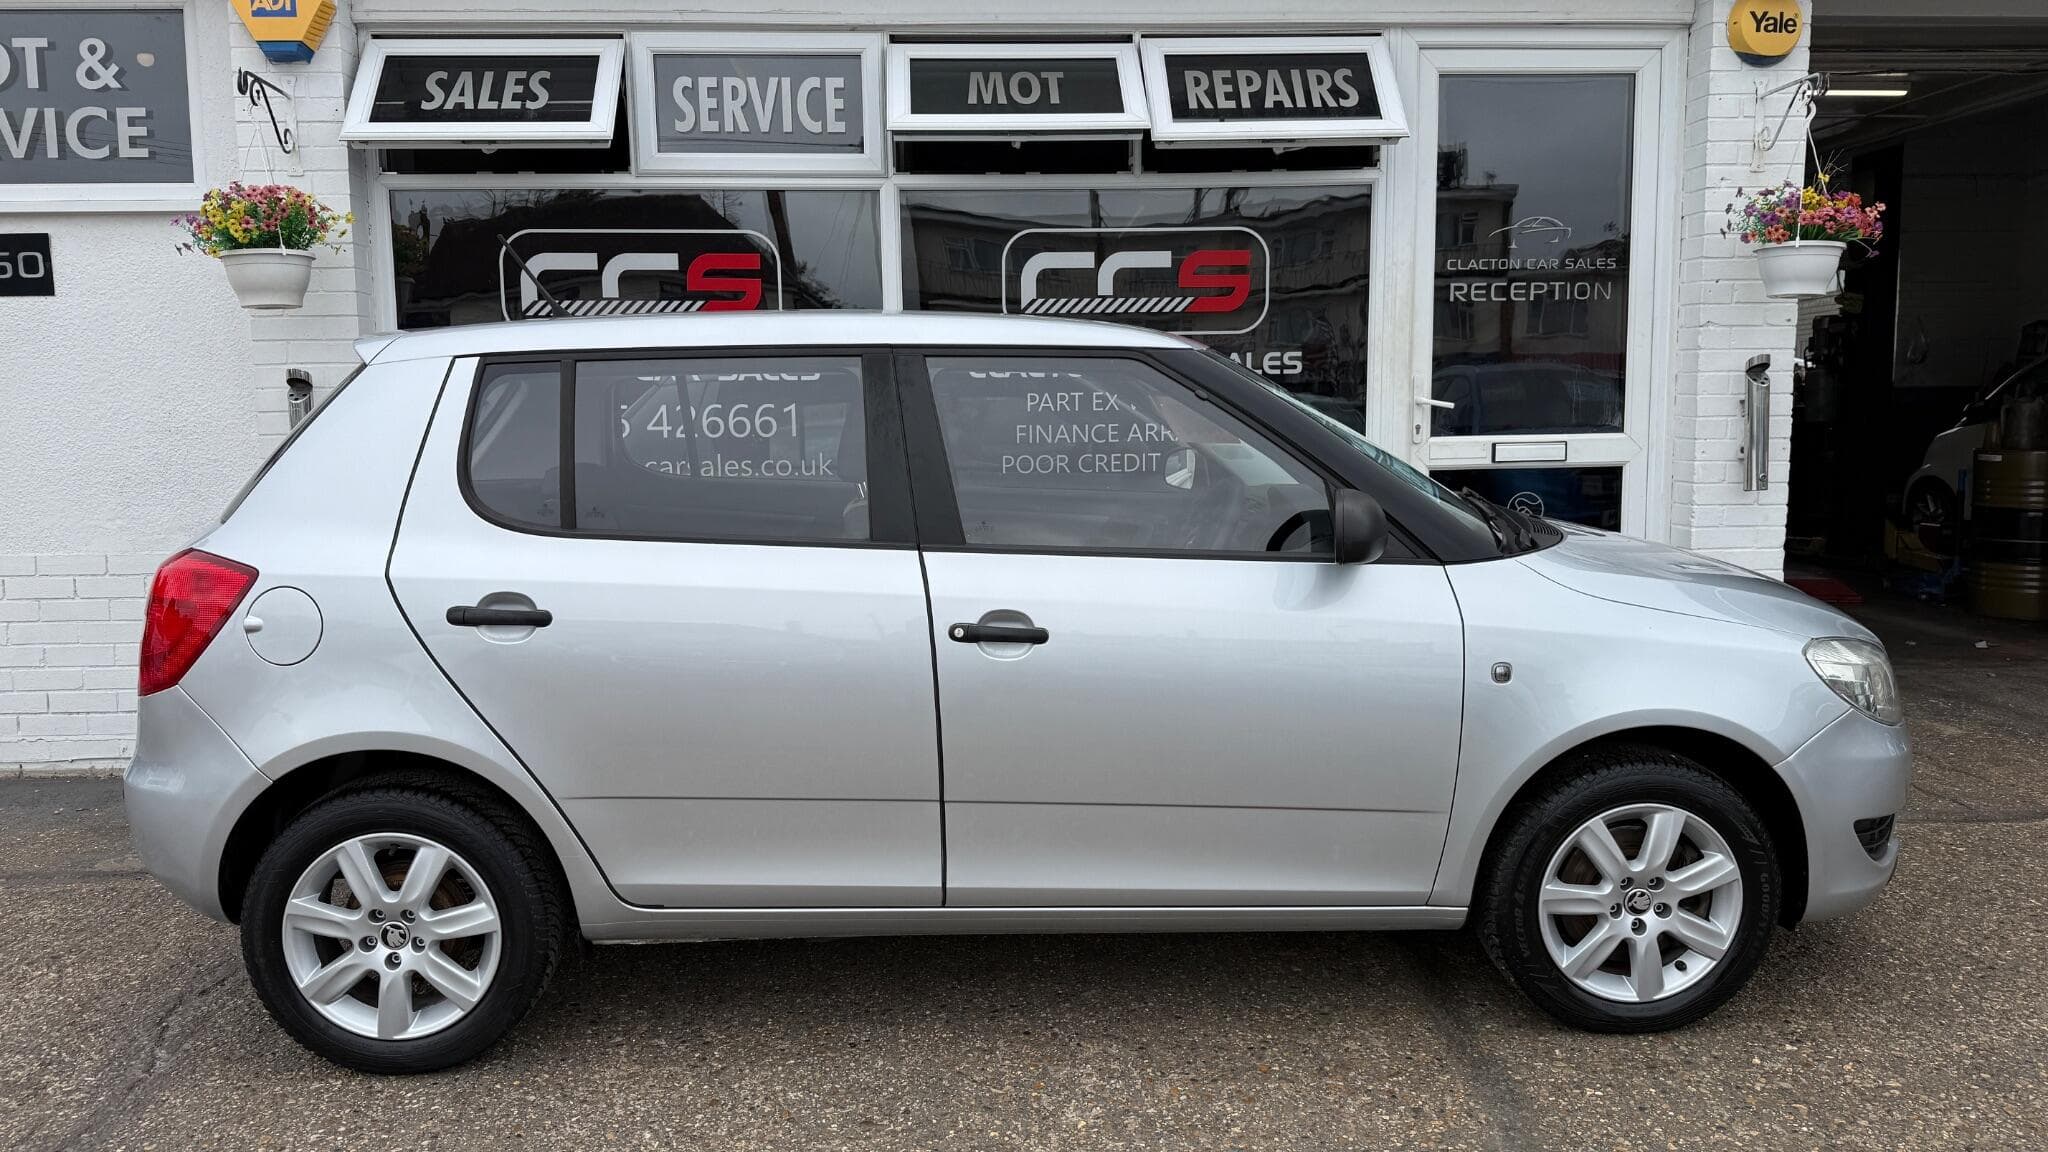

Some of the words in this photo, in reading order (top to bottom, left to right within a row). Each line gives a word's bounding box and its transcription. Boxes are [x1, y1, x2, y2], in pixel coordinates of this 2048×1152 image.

[1750, 11, 1797, 33] Yale
[76, 37, 122, 90] &
[421, 70, 551, 111] SALES
[967, 71, 1065, 105] MOT
[1183, 67, 1360, 110] REPAIRS
[672, 75, 847, 134] SERVICE
[1447, 258, 1520, 271] CLACTON
[1527, 258, 1559, 270] CAR
[1565, 257, 1617, 269] SALES
[1449, 281, 1612, 302] RECEPTION
[1027, 392, 1084, 412] PART
[1092, 391, 1120, 411] EX
[1016, 423, 1119, 444] FINANCE
[1002, 454, 1070, 474] POOR
[1078, 453, 1161, 473] CREDIT
